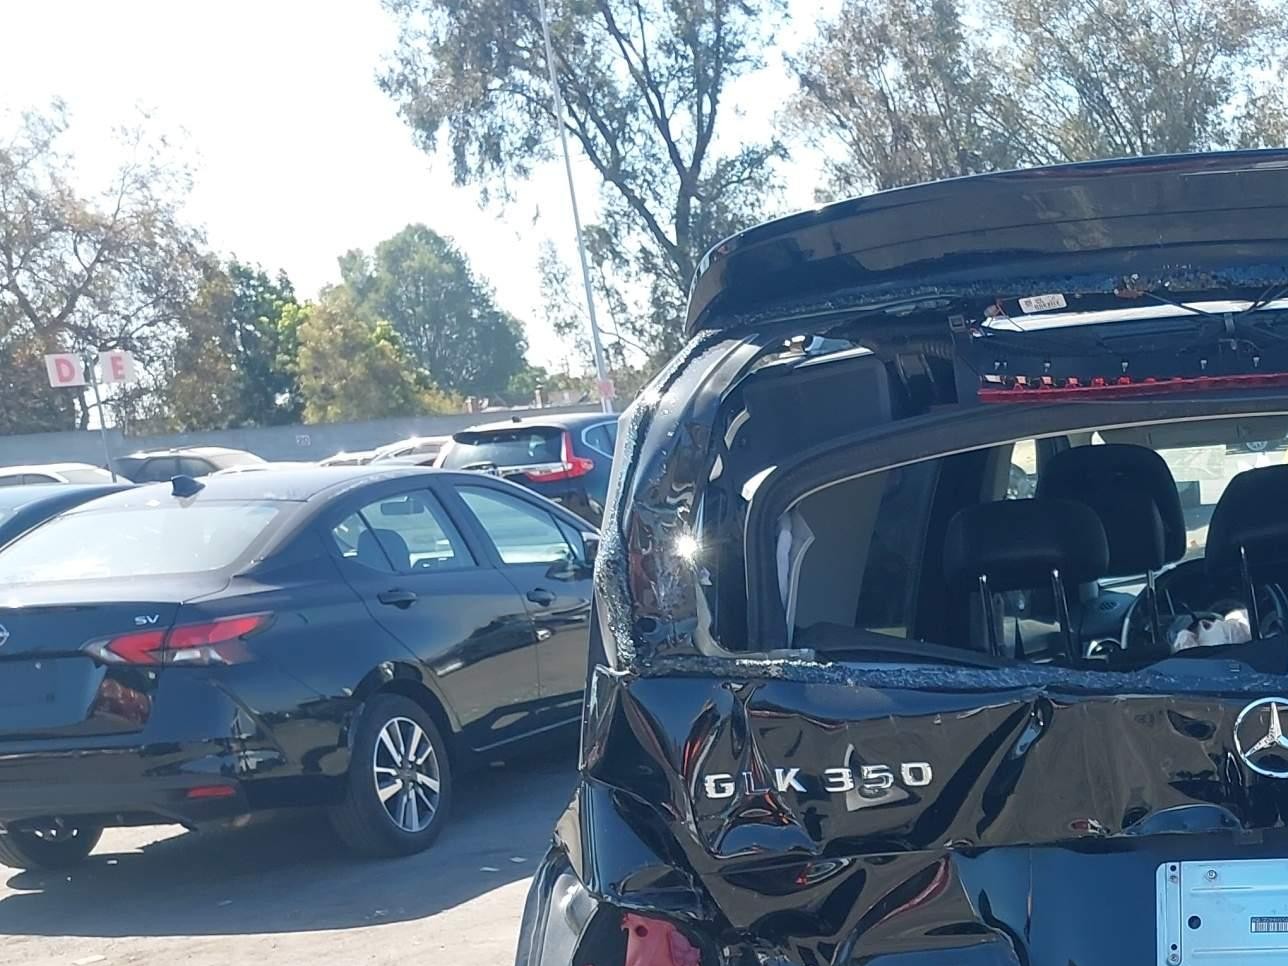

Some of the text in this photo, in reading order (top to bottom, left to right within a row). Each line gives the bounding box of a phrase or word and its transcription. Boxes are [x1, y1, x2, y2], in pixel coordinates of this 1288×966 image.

[54, 356, 125, 383] D E
[134, 614, 160, 625] SV
[704, 762, 933, 799] GLK 350
